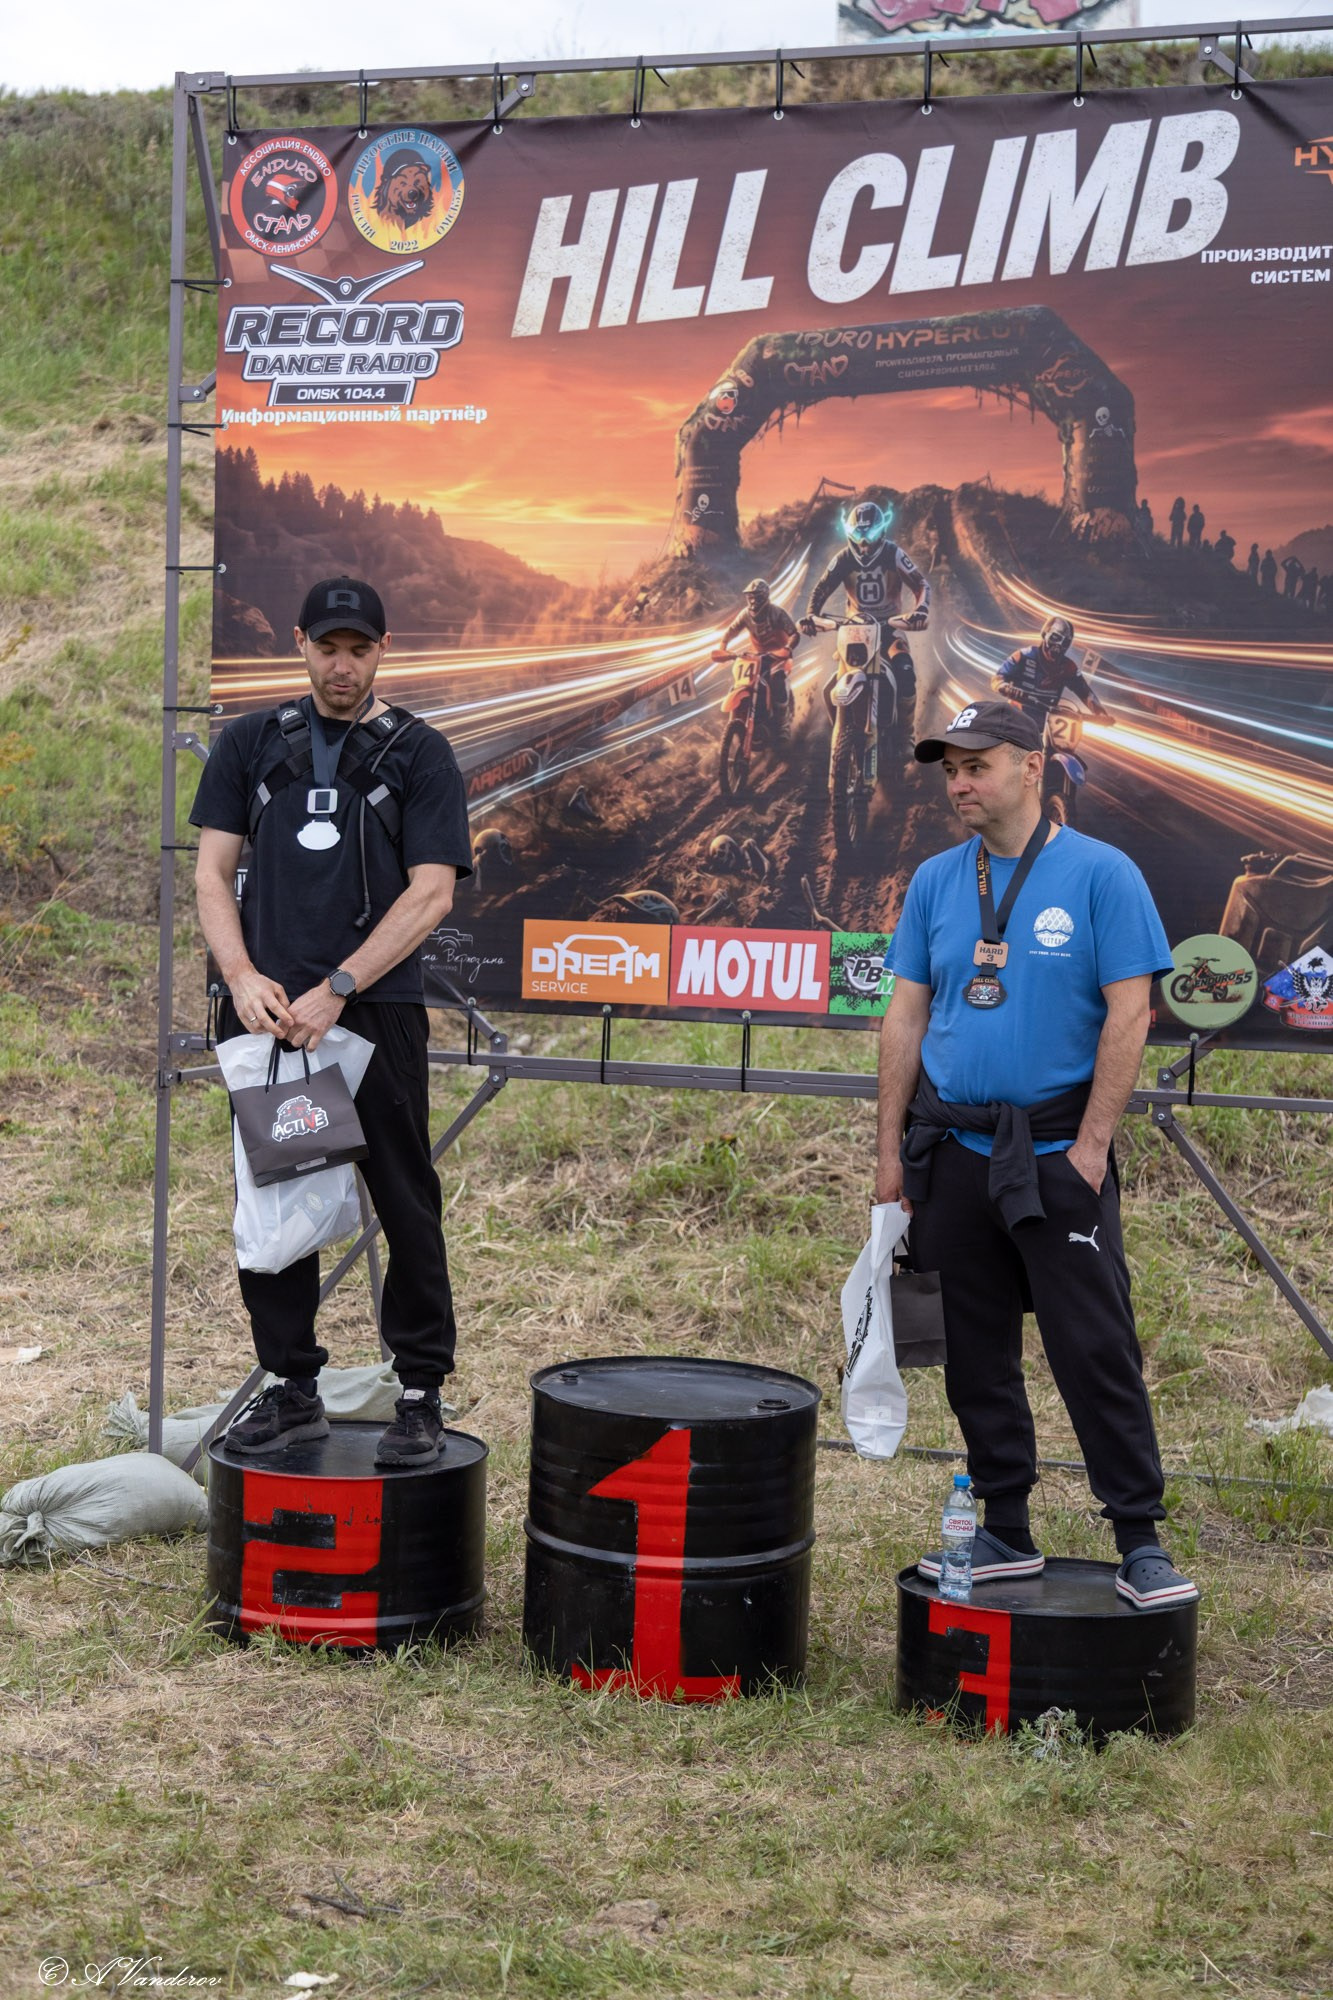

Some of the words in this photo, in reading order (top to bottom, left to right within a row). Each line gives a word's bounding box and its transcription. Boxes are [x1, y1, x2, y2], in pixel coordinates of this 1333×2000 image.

[251, 159, 317, 187] ENDURO
[511, 168, 774, 338] HILL
[807, 109, 1240, 304] CLIMB
[390, 239, 419, 251] 2022
[1250, 268, 1331, 284] СИСТЕМ
[227, 305, 464, 347] RECORD
[247, 354, 345, 376] DANCE
[346, 352, 435, 375] RADIO
[297, 387, 340, 400] OMSK
[343, 386, 386, 399] 104.4
[221, 406, 401, 424] Информационный
[406, 405, 488, 424] партнёр
[737, 662, 755, 682] 14
[1054, 717, 1077, 743] 21
[531, 943, 661, 984] DREAM
[979, 946, 1003, 957] HARD
[986, 954, 994, 963] 3
[676, 938, 823, 1001] MOTUL
[1194, 973, 1237, 987] ENDURO
[531, 981, 588, 994] SERVICE
[275, 1110, 325, 1138] ACTIVE
[241, 1469, 384, 1647] 2
[570, 1427, 743, 1705] 1
